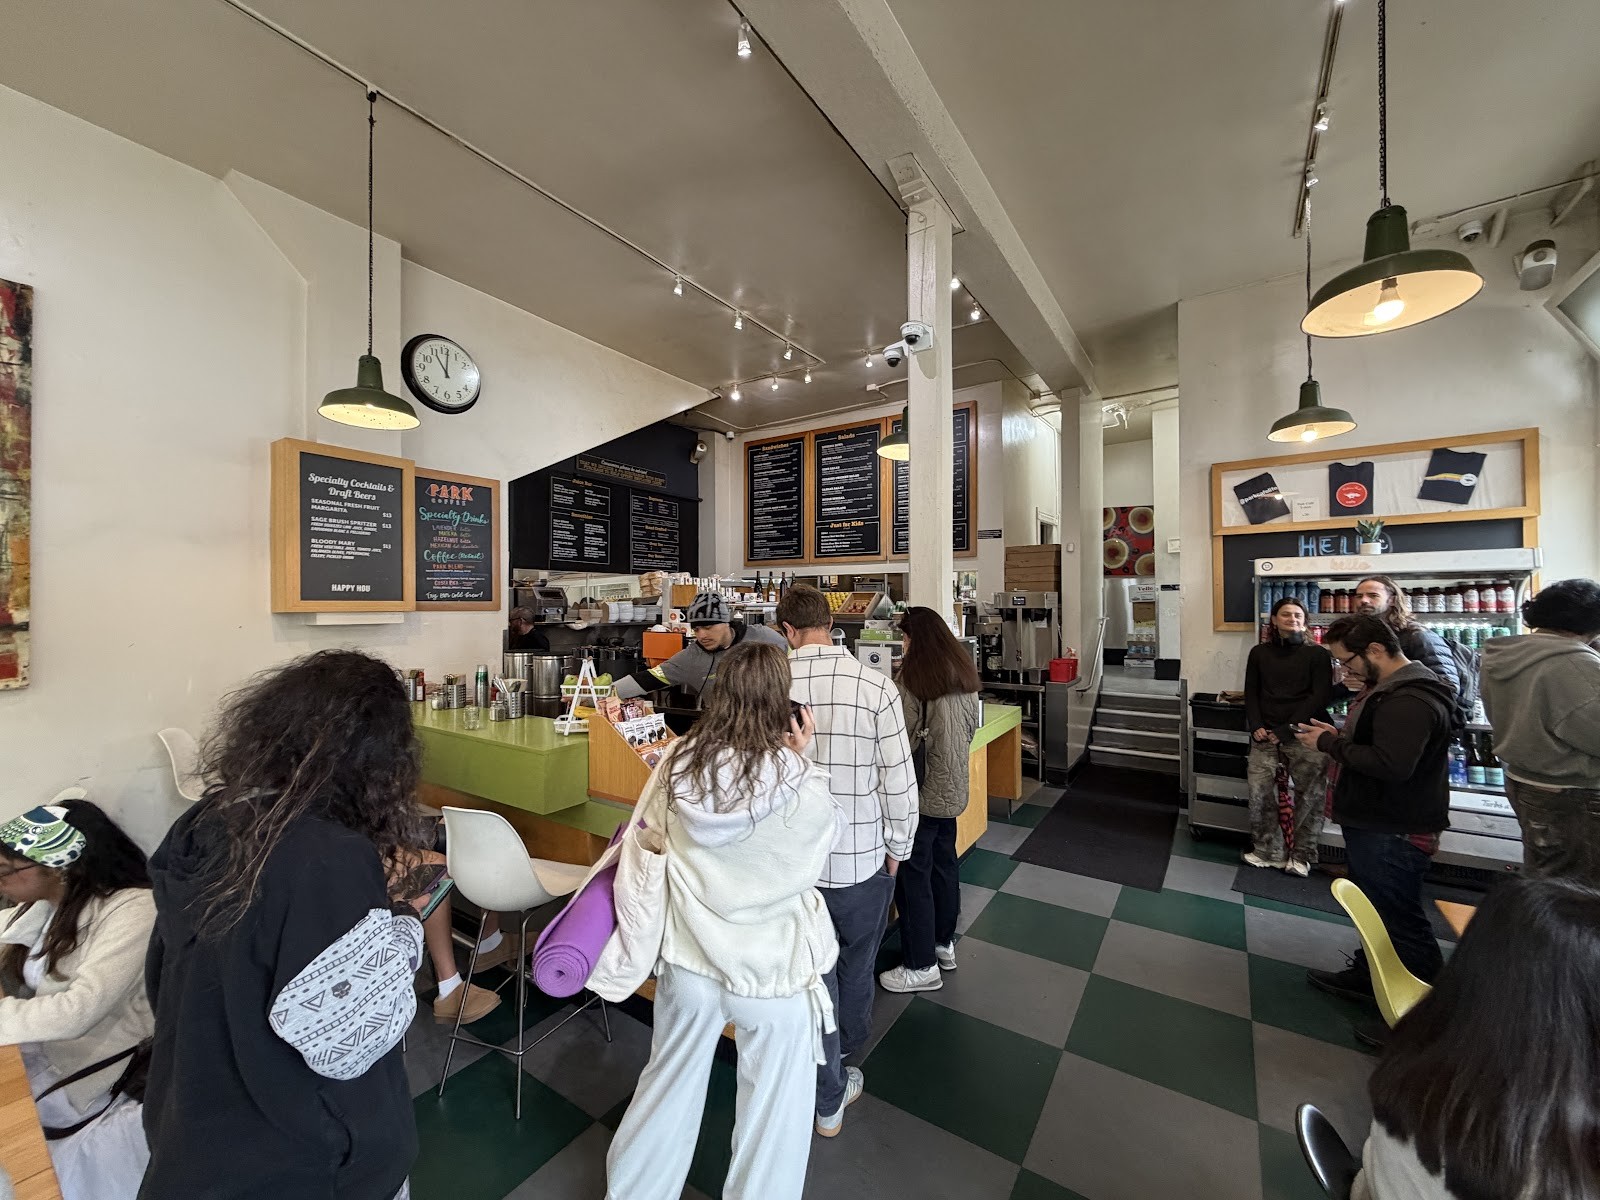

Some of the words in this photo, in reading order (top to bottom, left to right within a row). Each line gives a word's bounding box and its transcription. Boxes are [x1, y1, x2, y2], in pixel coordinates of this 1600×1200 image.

[431, 347, 438, 356] 11
[440, 347, 449, 356] 12
[422, 354, 432, 363] 10
[419, 363, 426, 371] 9
[461, 362, 466, 370] 2
[444, 391, 450, 399] 6
[456, 390, 462, 398] 5
[308, 472, 349, 488] Specialty
[350, 478, 386, 492] Cocktails
[328, 487, 352, 499] Draft
[353, 490, 376, 500] Beers
[429, 484, 474, 501] PARK
[311, 498, 343, 506] SEASONAL
[430, 498, 466, 506] COFFEE
[311, 504, 348, 513] MARGARITA
[419, 507, 461, 527] Specialty
[462, 511, 489, 524] Drinks
[424, 550, 458, 563] Coffee
[426, 592, 438, 600] Try
